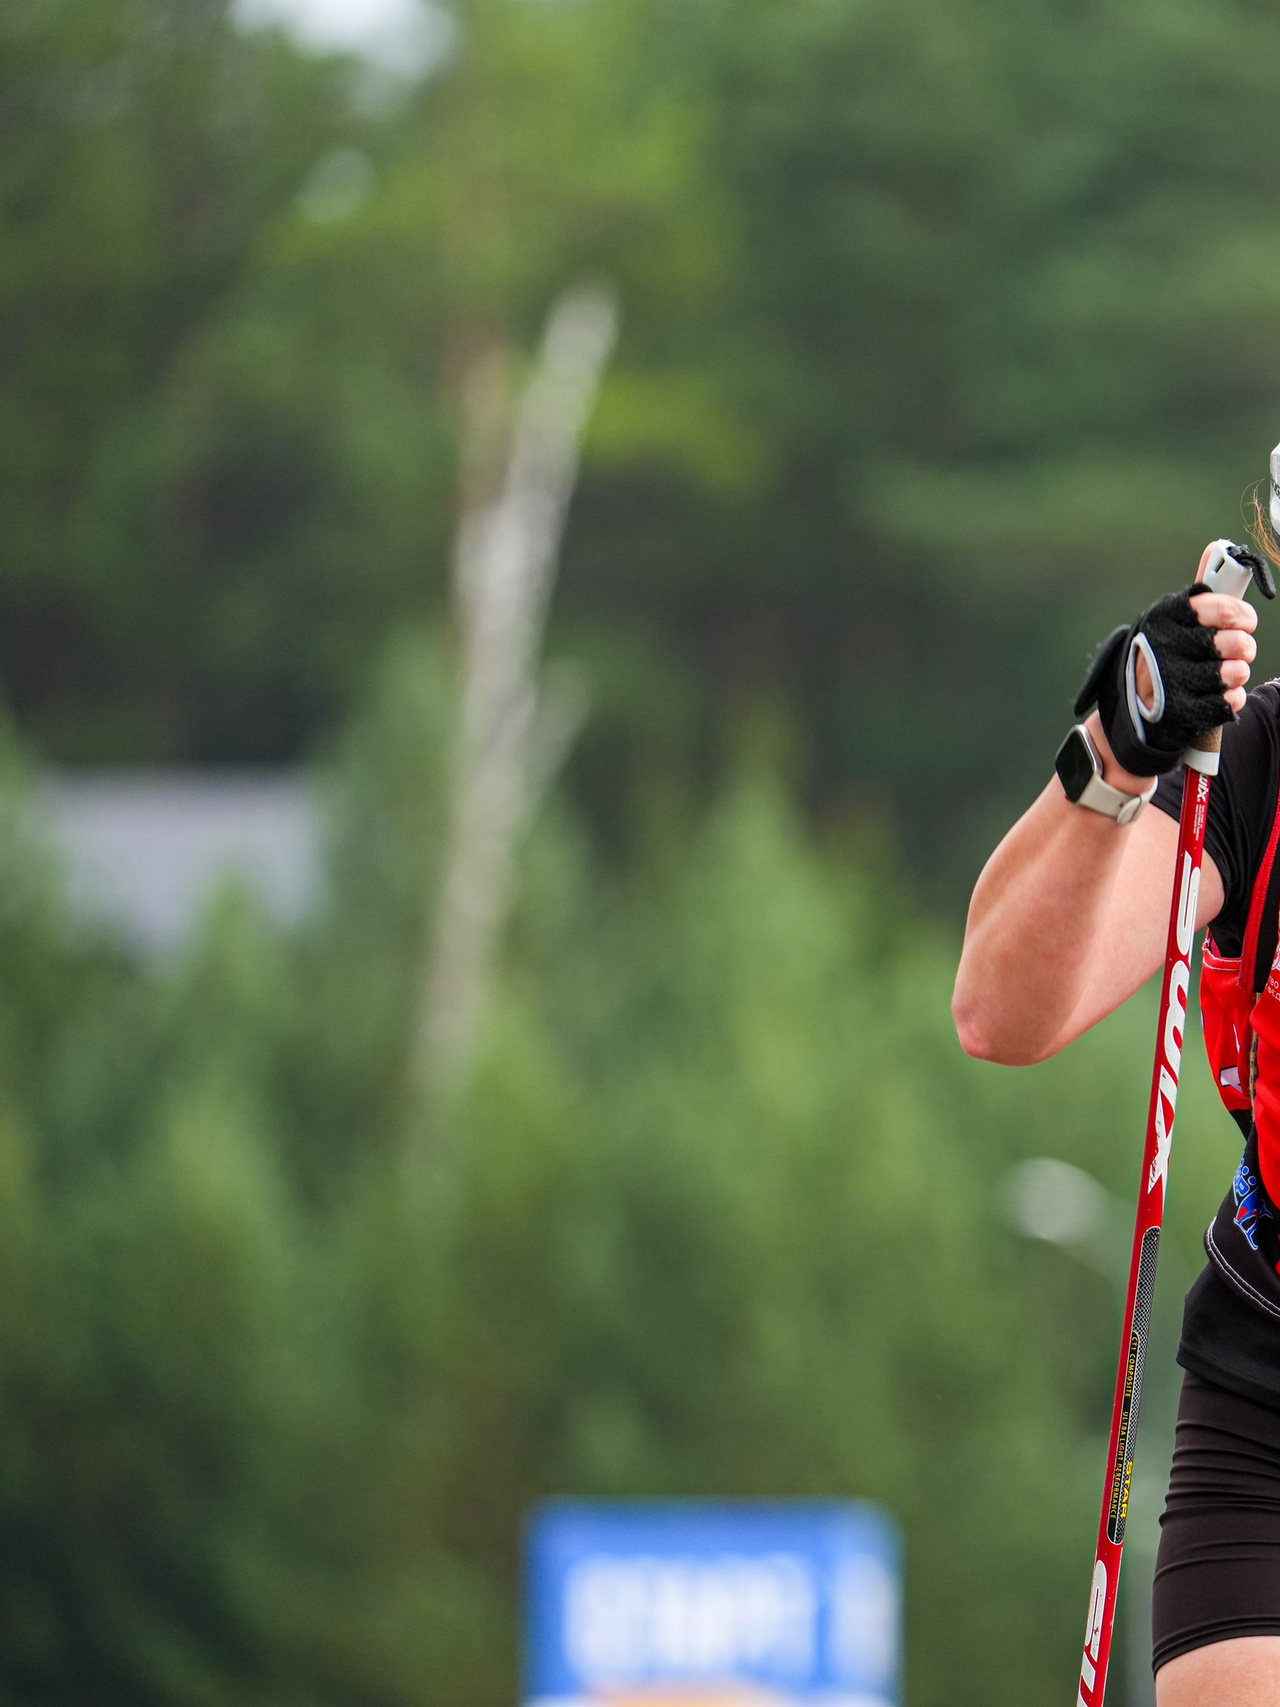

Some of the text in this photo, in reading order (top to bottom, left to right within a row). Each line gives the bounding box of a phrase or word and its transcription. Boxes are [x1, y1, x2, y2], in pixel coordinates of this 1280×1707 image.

[1124, 1353, 1136, 1398] COMPOSITE
[1110, 1411, 1129, 1519] ULTRA LIGHT PERFORMANCE
[1120, 1461, 1134, 1519] STAR
